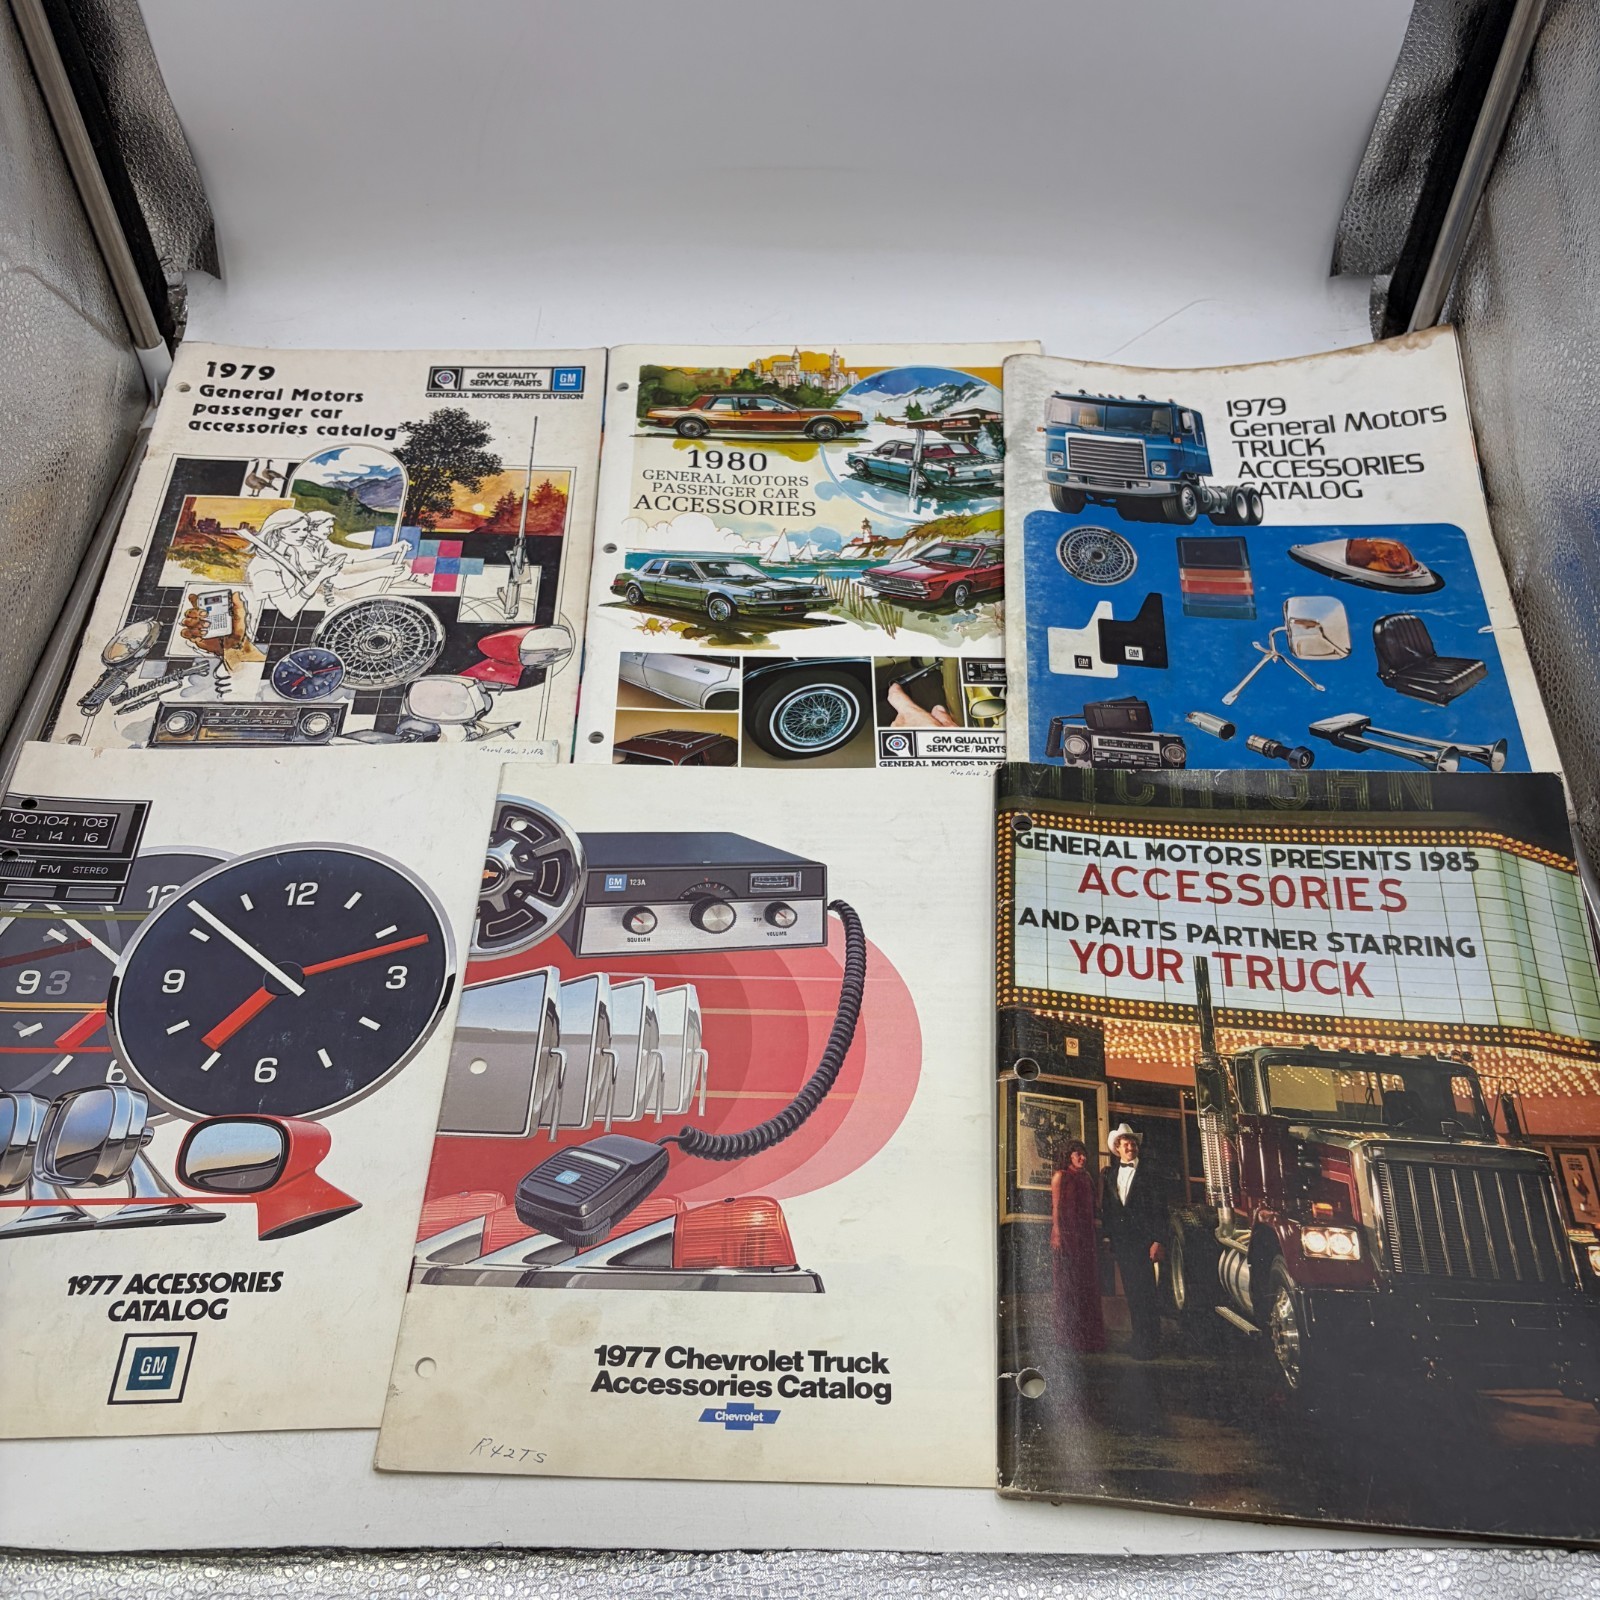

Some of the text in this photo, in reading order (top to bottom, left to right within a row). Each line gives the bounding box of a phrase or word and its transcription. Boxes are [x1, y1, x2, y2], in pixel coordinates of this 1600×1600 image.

[206, 361, 276, 380] 1979
[497, 372, 538, 380] QUALITY
[560, 373, 576, 382] GM
[199, 384, 364, 402] General Motors
[470, 379, 542, 387] SERVICE/PARTS
[192, 404, 343, 420] passenger car
[1226, 397, 1287, 417] 1979
[188, 420, 398, 440] accessories catalog
[1230, 404, 1447, 437] General Motors
[1232, 438, 1326, 458] TRUCK
[687, 449, 768, 472] 1980
[1238, 453, 1425, 478] ACCESSORIES
[642, 469, 809, 486] GENERAL MOTORS
[652, 482, 799, 498] PASSENGER CAR
[633, 494, 816, 517] ACCESSORIES
[932, 736, 1000, 744] GM QUALITY
[879, 760, 928, 768] GENERAL
[43, 816, 70, 826] 104
[82, 818, 108, 828] 108
[11, 828, 98, 842] 12 14 16
[1016, 831, 1480, 873] GENERAL MOTORS PRESENTS 1985
[39, 864, 108, 874] FM STEREO
[608, 878, 646, 886] GM 123A
[1078, 862, 1408, 913] ACCESSORIES
[284, 882, 318, 906] 12
[1018, 906, 1476, 959] AND PARTS PARTNER STARRING
[385, 965, 408, 990] 3
[1069, 938, 1375, 998] YOUR TRUCK
[162, 969, 186, 994] 9
[254, 1057, 278, 1083] 6
[67, 1271, 284, 1296] 1977 ACCESSORIES
[108, 1298, 229, 1322] CATALOG
[140, 1356, 168, 1374] GM
[594, 1345, 890, 1374] 1977 Chevrolet Truck
[590, 1370, 892, 1406] Accessories Catalog
[714, 1411, 764, 1422] Chevrolet
